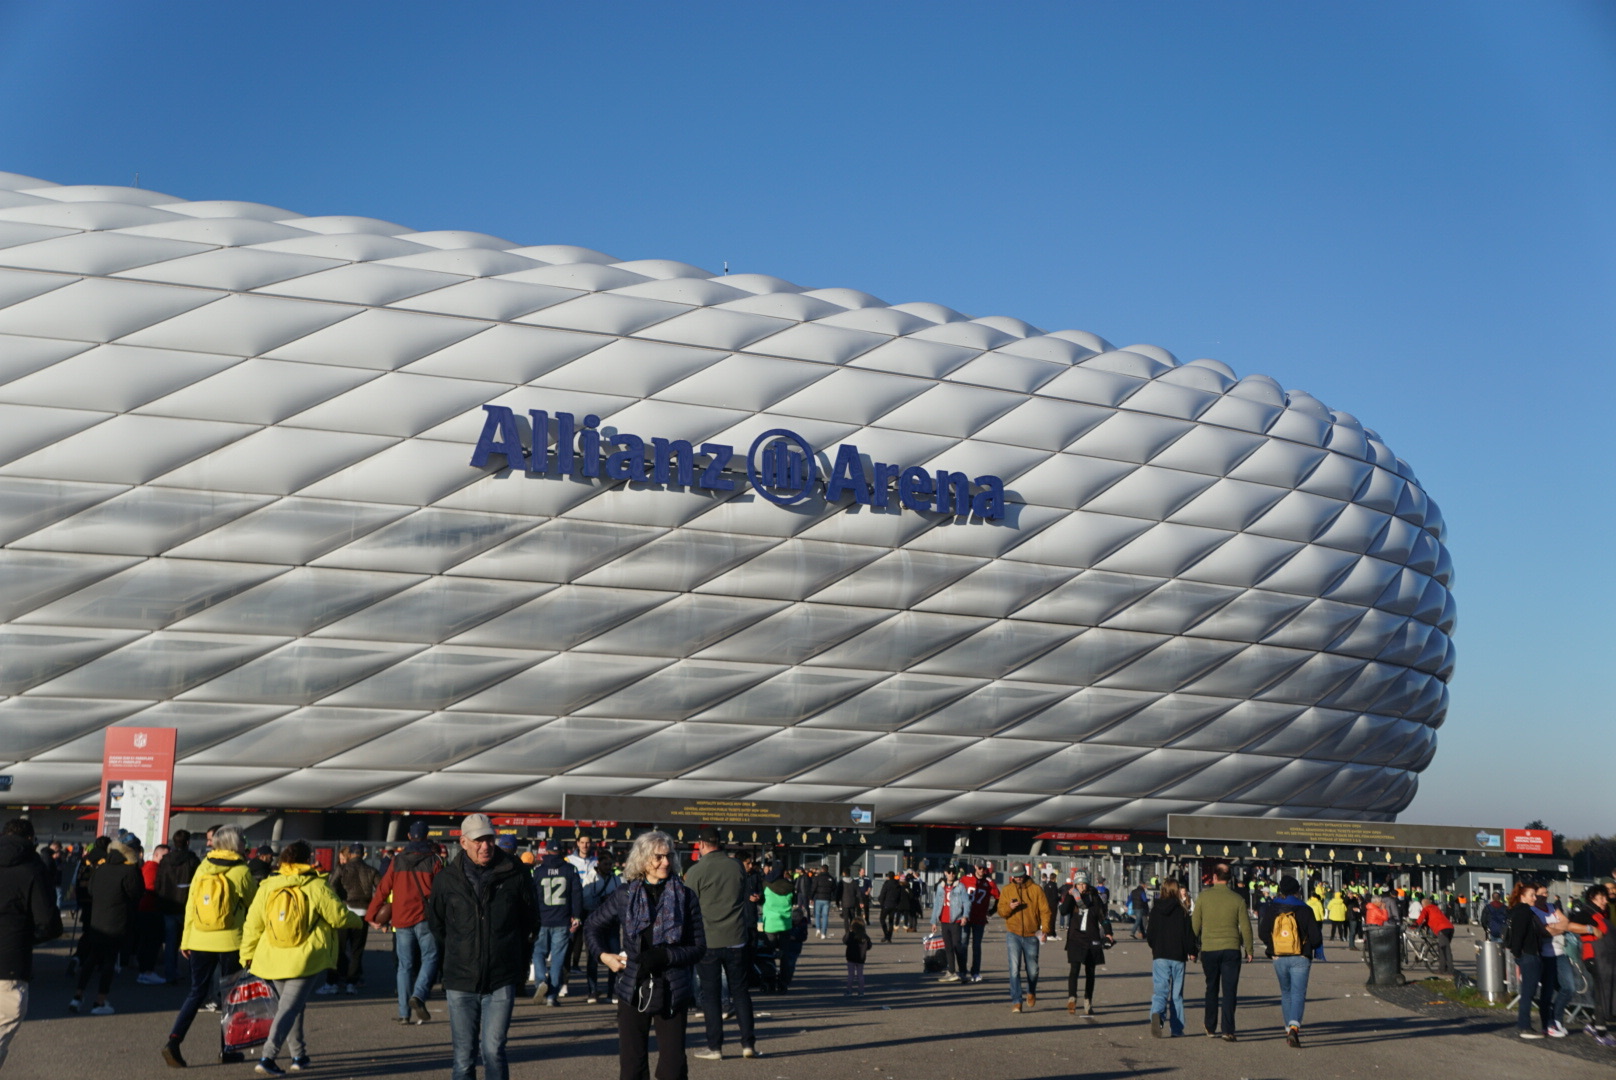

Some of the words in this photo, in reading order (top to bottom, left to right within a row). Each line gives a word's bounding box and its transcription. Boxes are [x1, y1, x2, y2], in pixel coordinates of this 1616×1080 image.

[470, 404, 735, 491] Allianz
[826, 444, 1005, 520] Arena
[541, 876, 566, 906] 12
